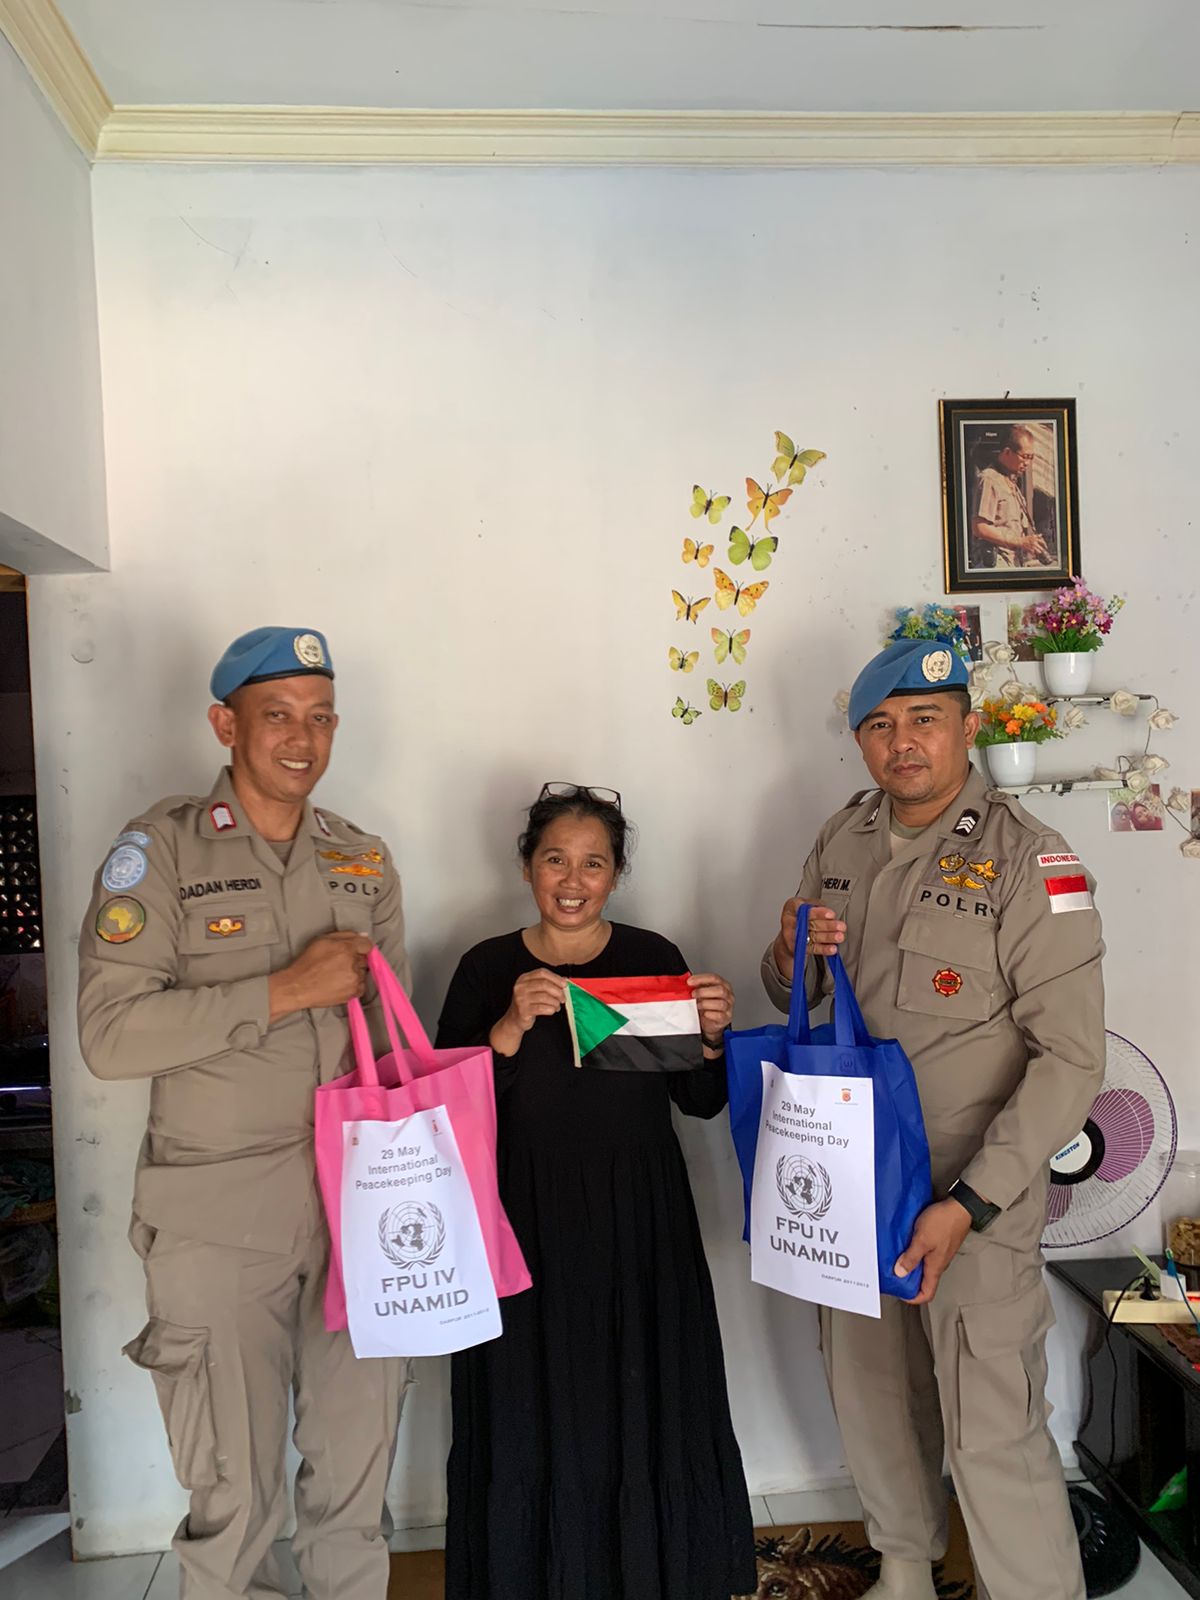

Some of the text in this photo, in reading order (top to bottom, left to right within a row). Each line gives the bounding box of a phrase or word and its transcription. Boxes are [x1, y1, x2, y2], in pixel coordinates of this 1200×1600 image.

[179, 878, 262, 900] DADAN HERDI
[772, 1110, 832, 1131] International
[780, 1100, 816, 1117] 29 May
[765, 1119, 850, 1149] Peacekeeping Day
[368, 1154, 439, 1175] International
[380, 1145, 421, 1160] 29 May
[355, 1166, 453, 1191] Peacekeeping Day
[776, 1216, 839, 1245] FPU IV
[770, 1235, 850, 1269] UNAMID
[381, 1267, 456, 1294] FPU IV
[374, 1289, 469, 1317] UNAMID
